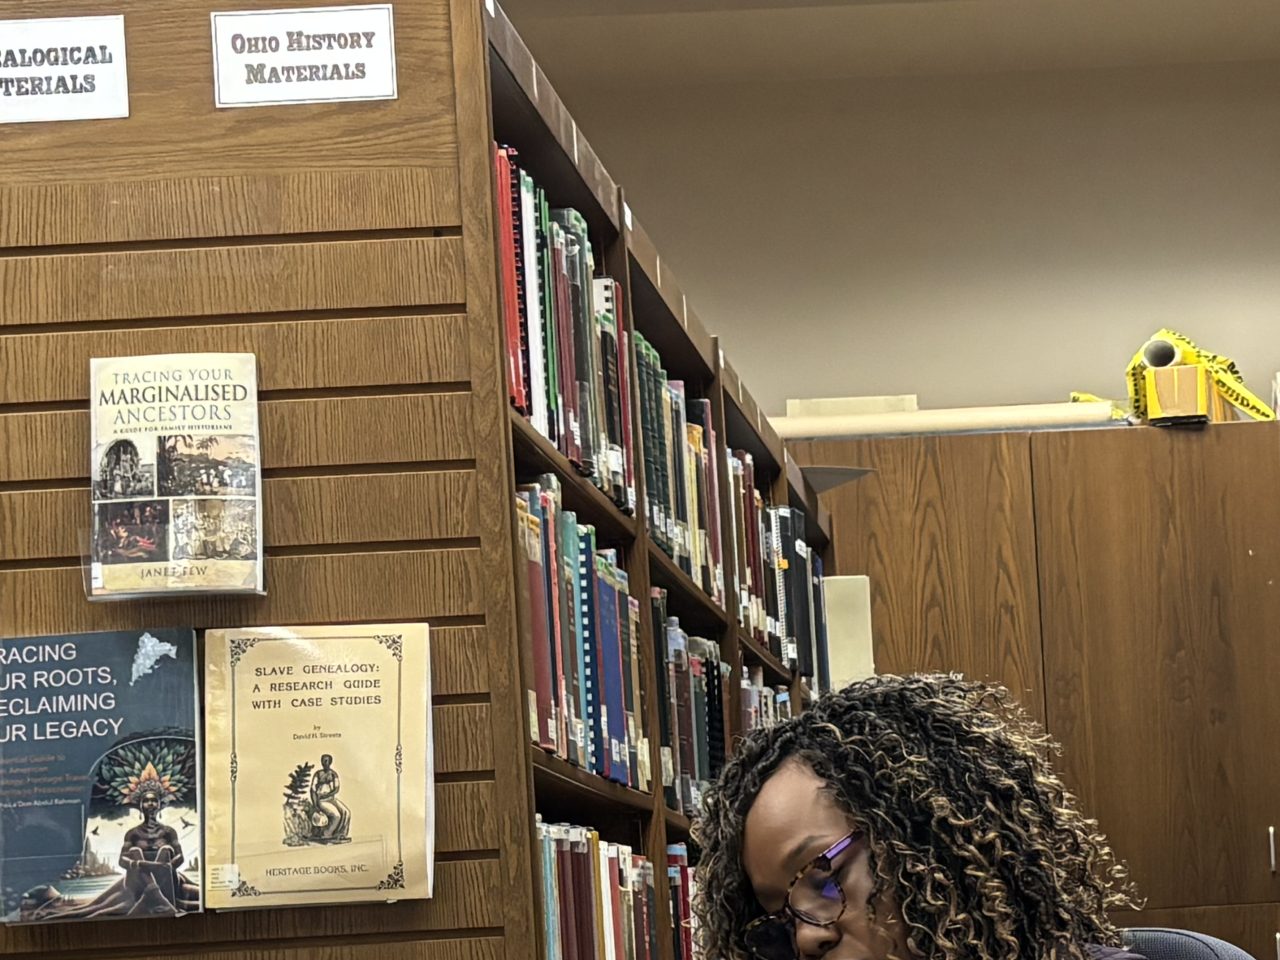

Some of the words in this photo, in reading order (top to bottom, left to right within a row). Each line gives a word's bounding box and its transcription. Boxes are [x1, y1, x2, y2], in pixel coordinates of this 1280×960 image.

[231, 33, 281, 54] OHIO
[286, 31, 376, 52] HISTORY
[0, 45, 113, 68] ALOGICAL
[244, 62, 366, 84] MATERIALS
[112, 370, 183, 385] TRACING
[188, 368, 233, 381] YOUR
[100, 384, 248, 406] MARGINALISED
[114, 404, 232, 425] ANCESTORS
[34, 666, 117, 688] ROOTS,
[254, 666, 294, 677] SLAVE
[303, 664, 380, 674] GENEALOGY:
[252, 684, 260, 694] A
[270, 680, 333, 692] RESEARCH
[344, 680, 381, 690] GUIDE
[252, 700, 282, 710] WITH
[291, 698, 323, 708] CASE
[330, 695, 382, 706] STUDIES
[34, 718, 124, 740] LEGACY
[266, 866, 312, 876] HERITAGE
[314, 866, 348, 875] BOOKS,
[350, 864, 369, 874] INC.
